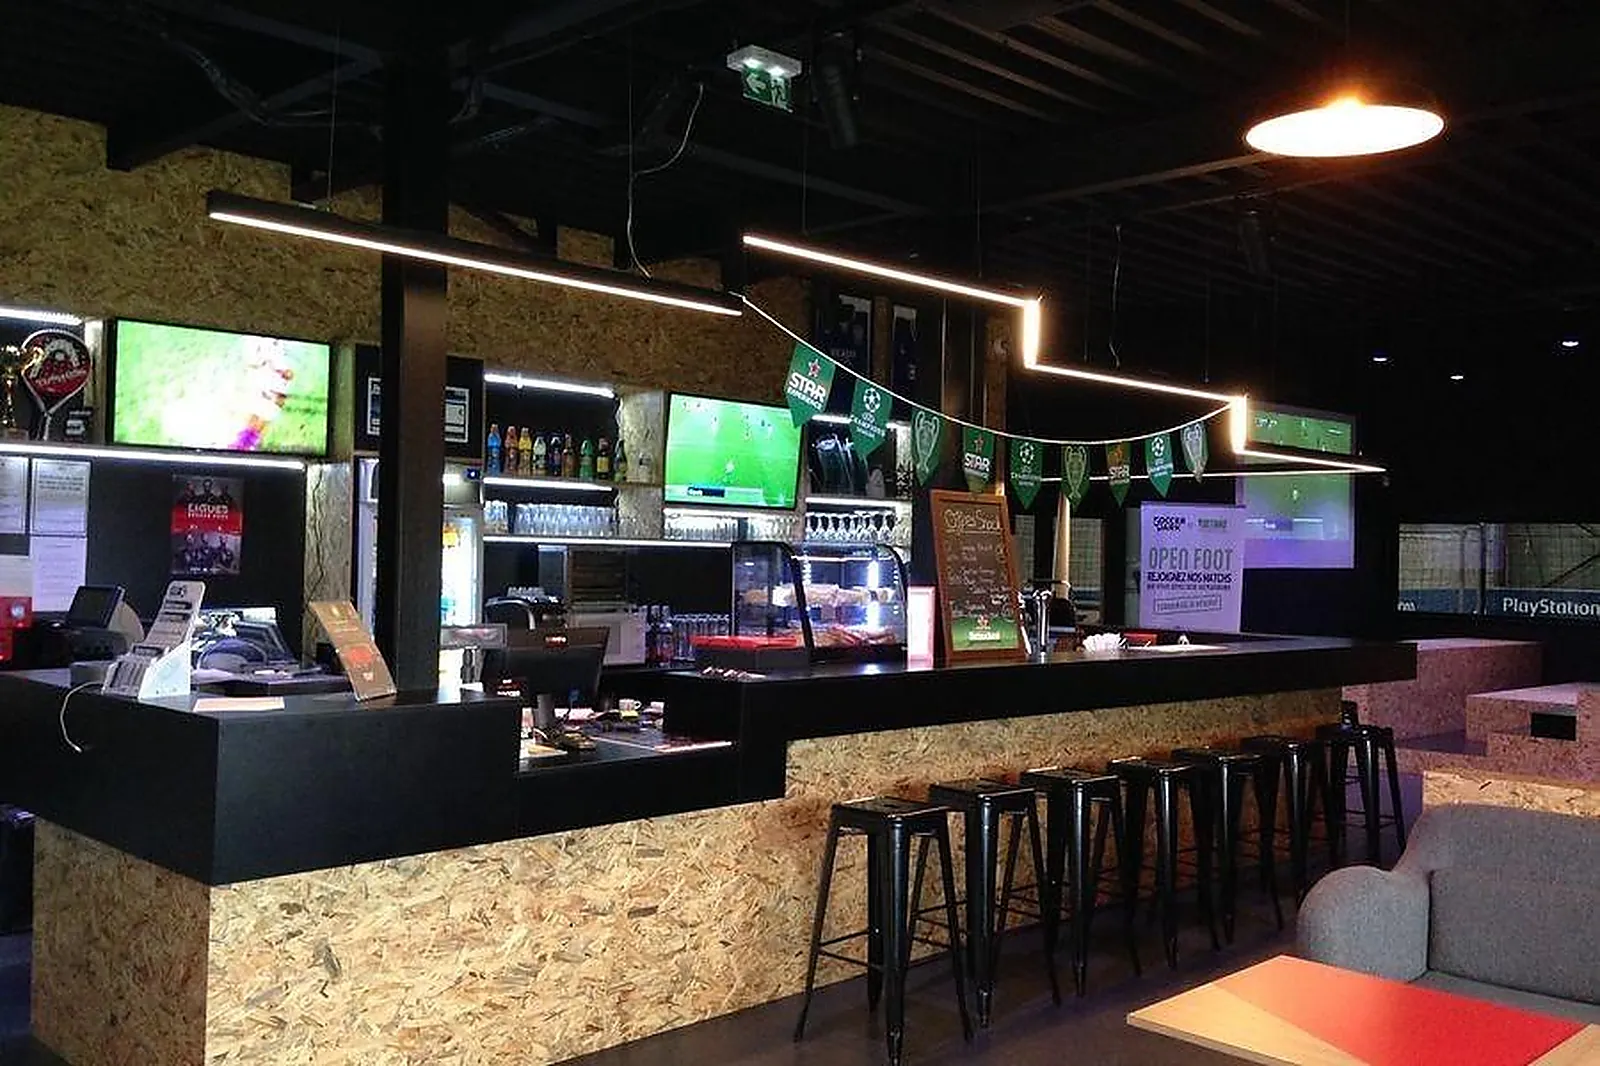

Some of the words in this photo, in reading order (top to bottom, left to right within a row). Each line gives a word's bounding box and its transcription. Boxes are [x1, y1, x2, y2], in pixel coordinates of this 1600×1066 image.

[788, 372, 826, 403] STAR
[964, 452, 991, 472] STAR
[1108, 464, 1130, 480] STAR
[188, 503, 228, 514] LIGUES
[1149, 547, 1188, 570] OPEN
[1194, 548, 1233, 571] FOOT
[1147, 571, 1185, 582] REJOIGNEZ
[1186, 572, 1203, 583] NOS
[1203, 572, 1234, 584] MATCHS
[1502, 597, 1600, 617] PlayStation
